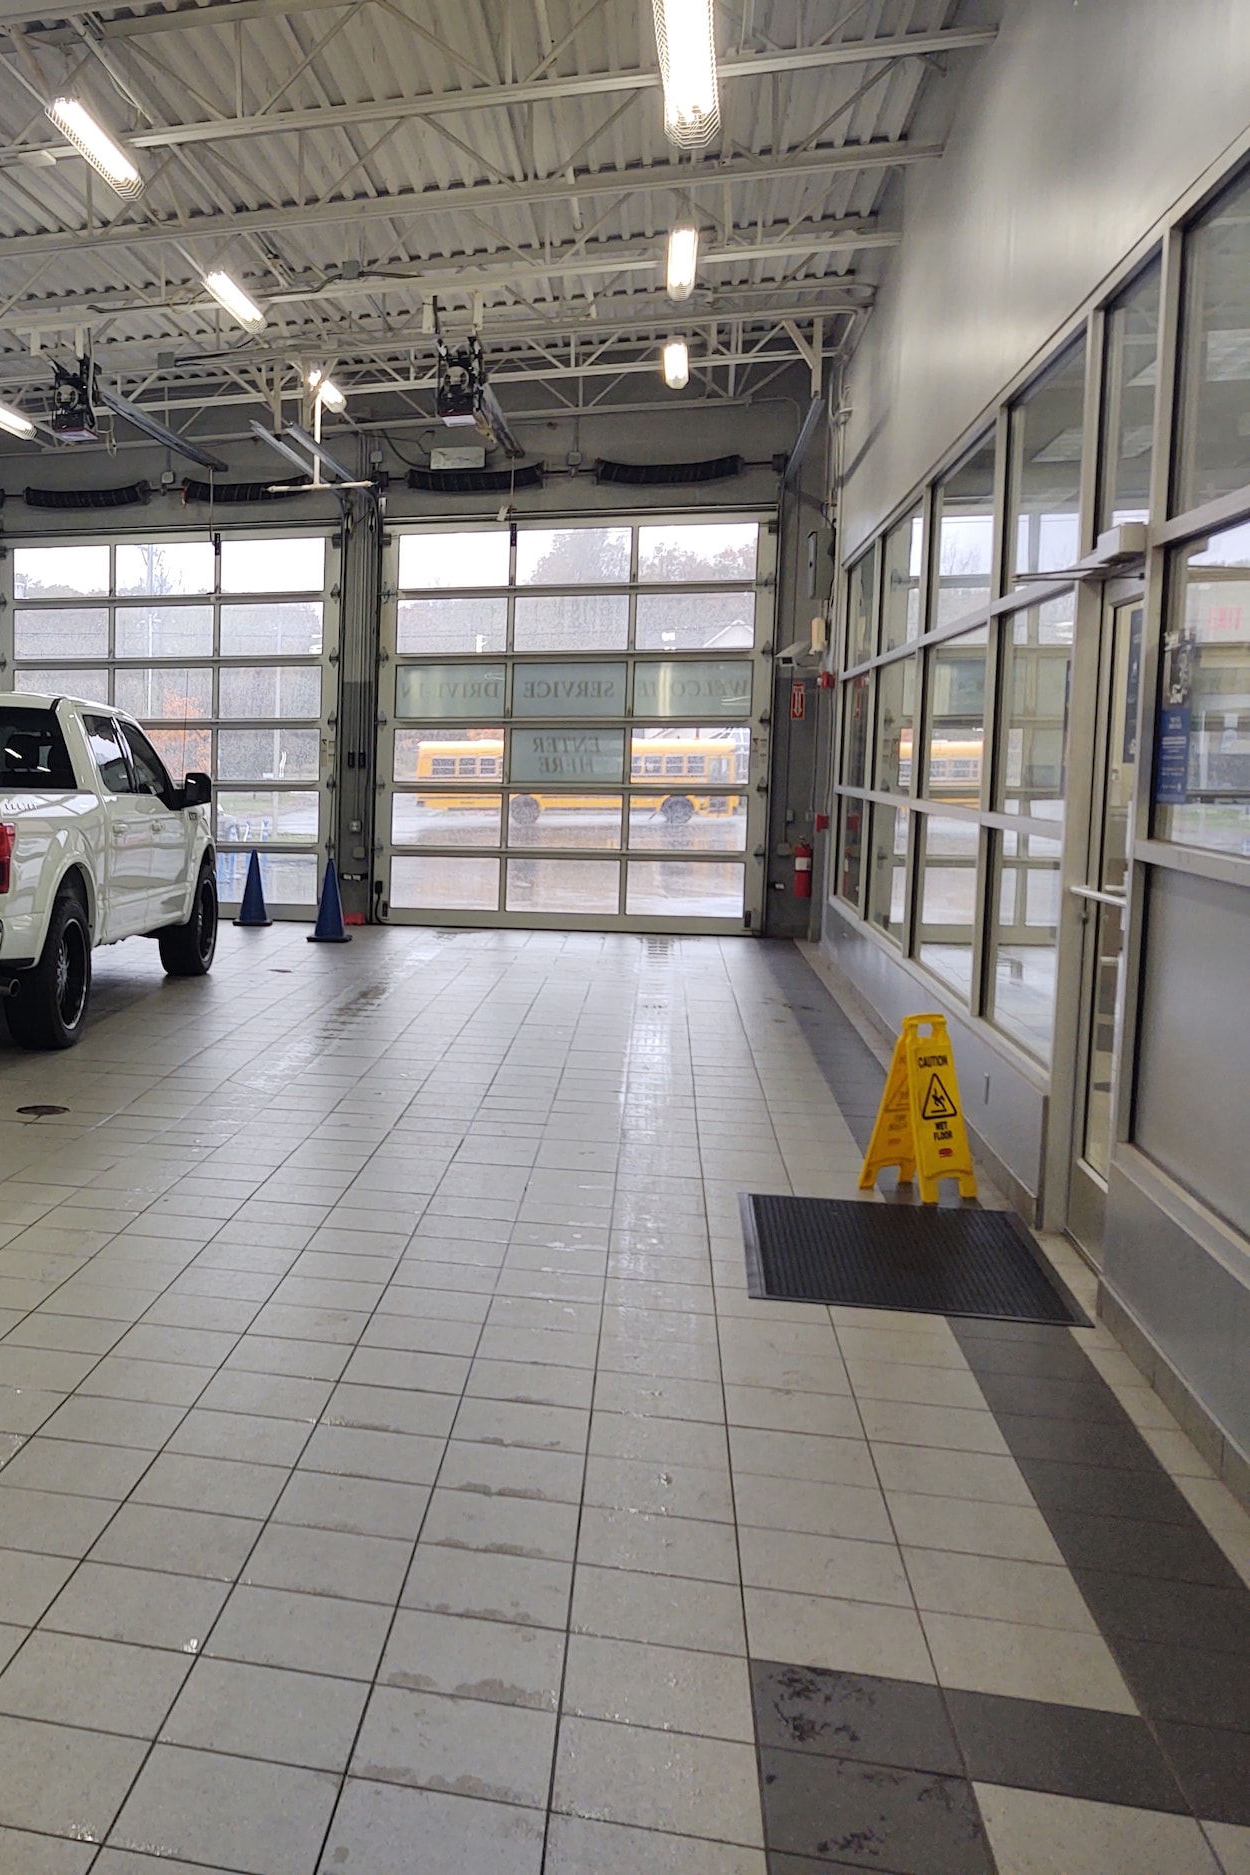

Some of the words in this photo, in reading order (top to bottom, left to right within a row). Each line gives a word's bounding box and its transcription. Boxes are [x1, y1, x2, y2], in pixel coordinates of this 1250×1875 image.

[918, 1055, 948, 1069] CAUTION
[935, 1122, 948, 1131] WET
[933, 1131, 953, 1141] FLOOR
